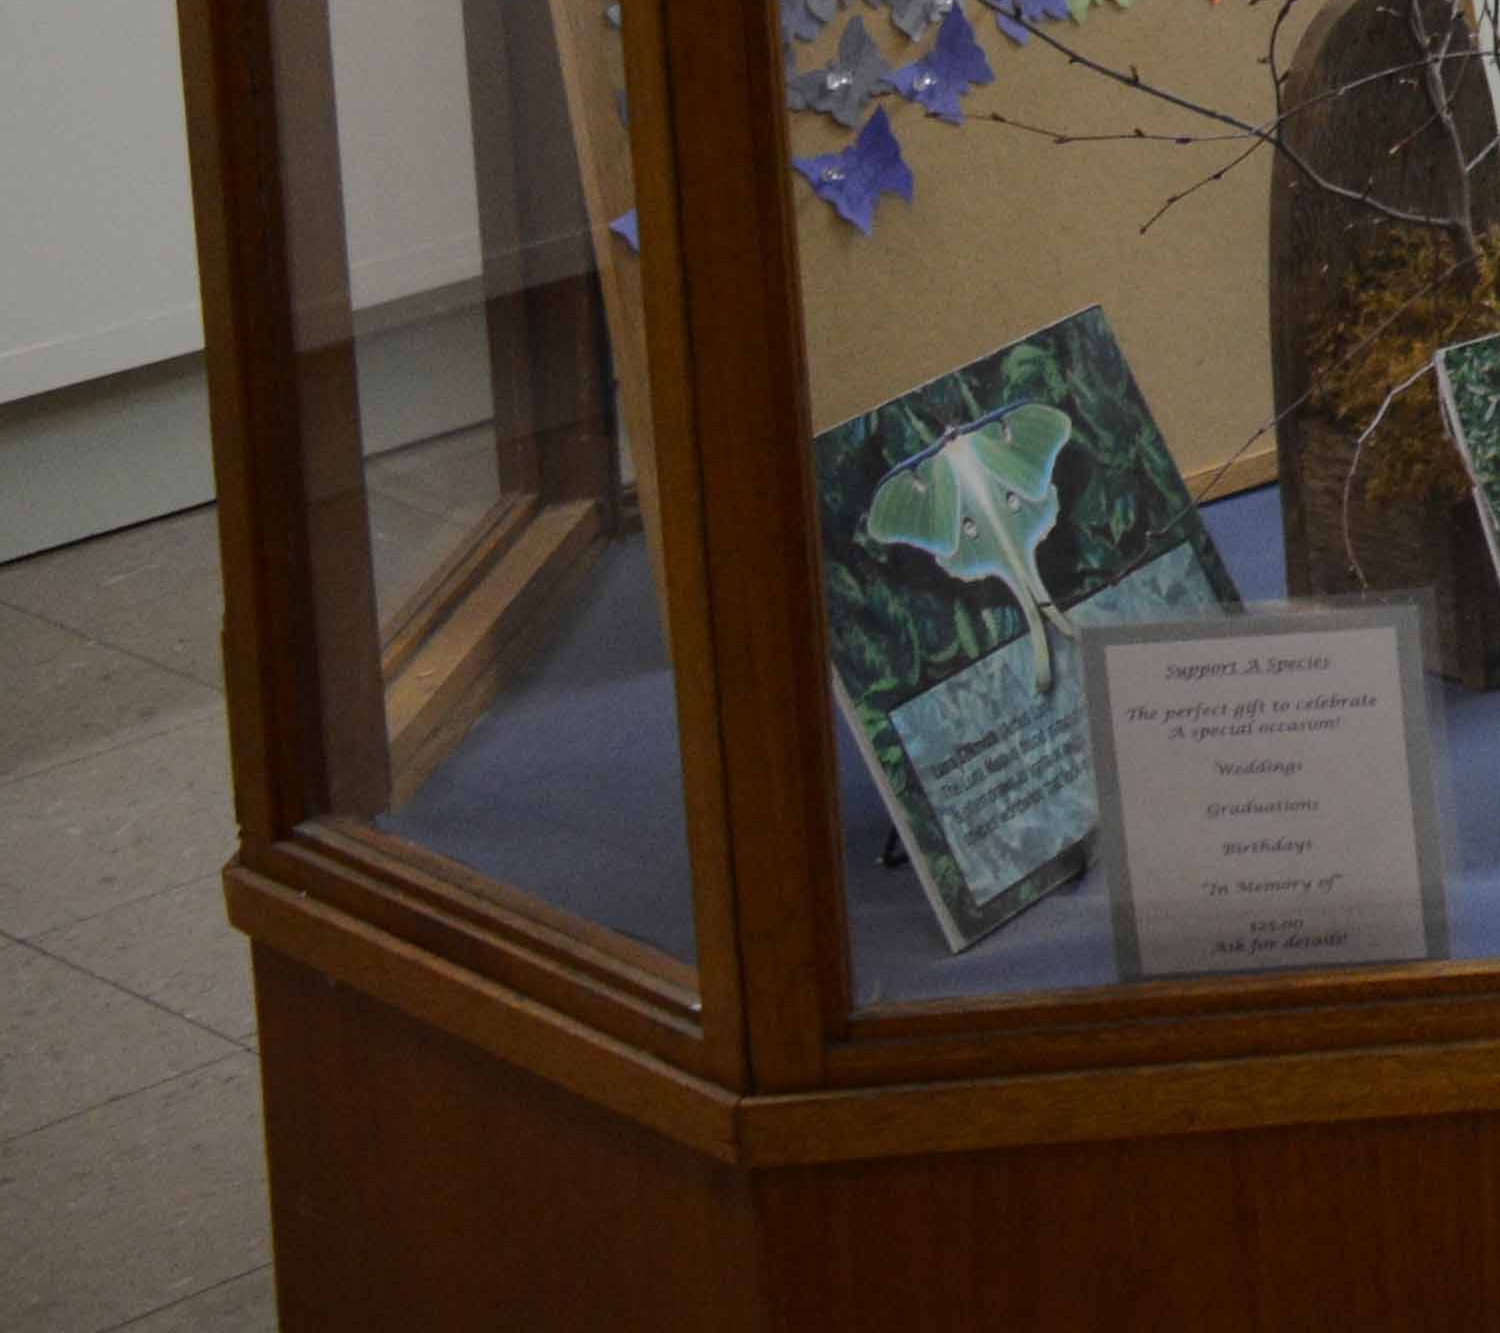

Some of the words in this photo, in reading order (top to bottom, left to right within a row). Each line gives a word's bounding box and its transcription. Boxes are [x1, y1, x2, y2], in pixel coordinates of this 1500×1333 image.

[1165, 660, 1238, 682] Support
[1266, 655, 1330, 676] Species
[1125, 705, 1158, 722] The
[1159, 701, 1228, 725] perfect
[1231, 697, 1265, 719] gift
[1272, 698, 1290, 712] to
[1296, 693, 1378, 711] celebrate
[1192, 719, 1252, 742] special
[1214, 758, 1304, 778] Weddings
[1205, 797, 1320, 819] Graduations
[1222, 836, 1313, 857] Birthdays
[1237, 876, 1313, 895] Memory
[1210, 935, 1245, 955] Ask
[1248, 935, 1278, 956] for
